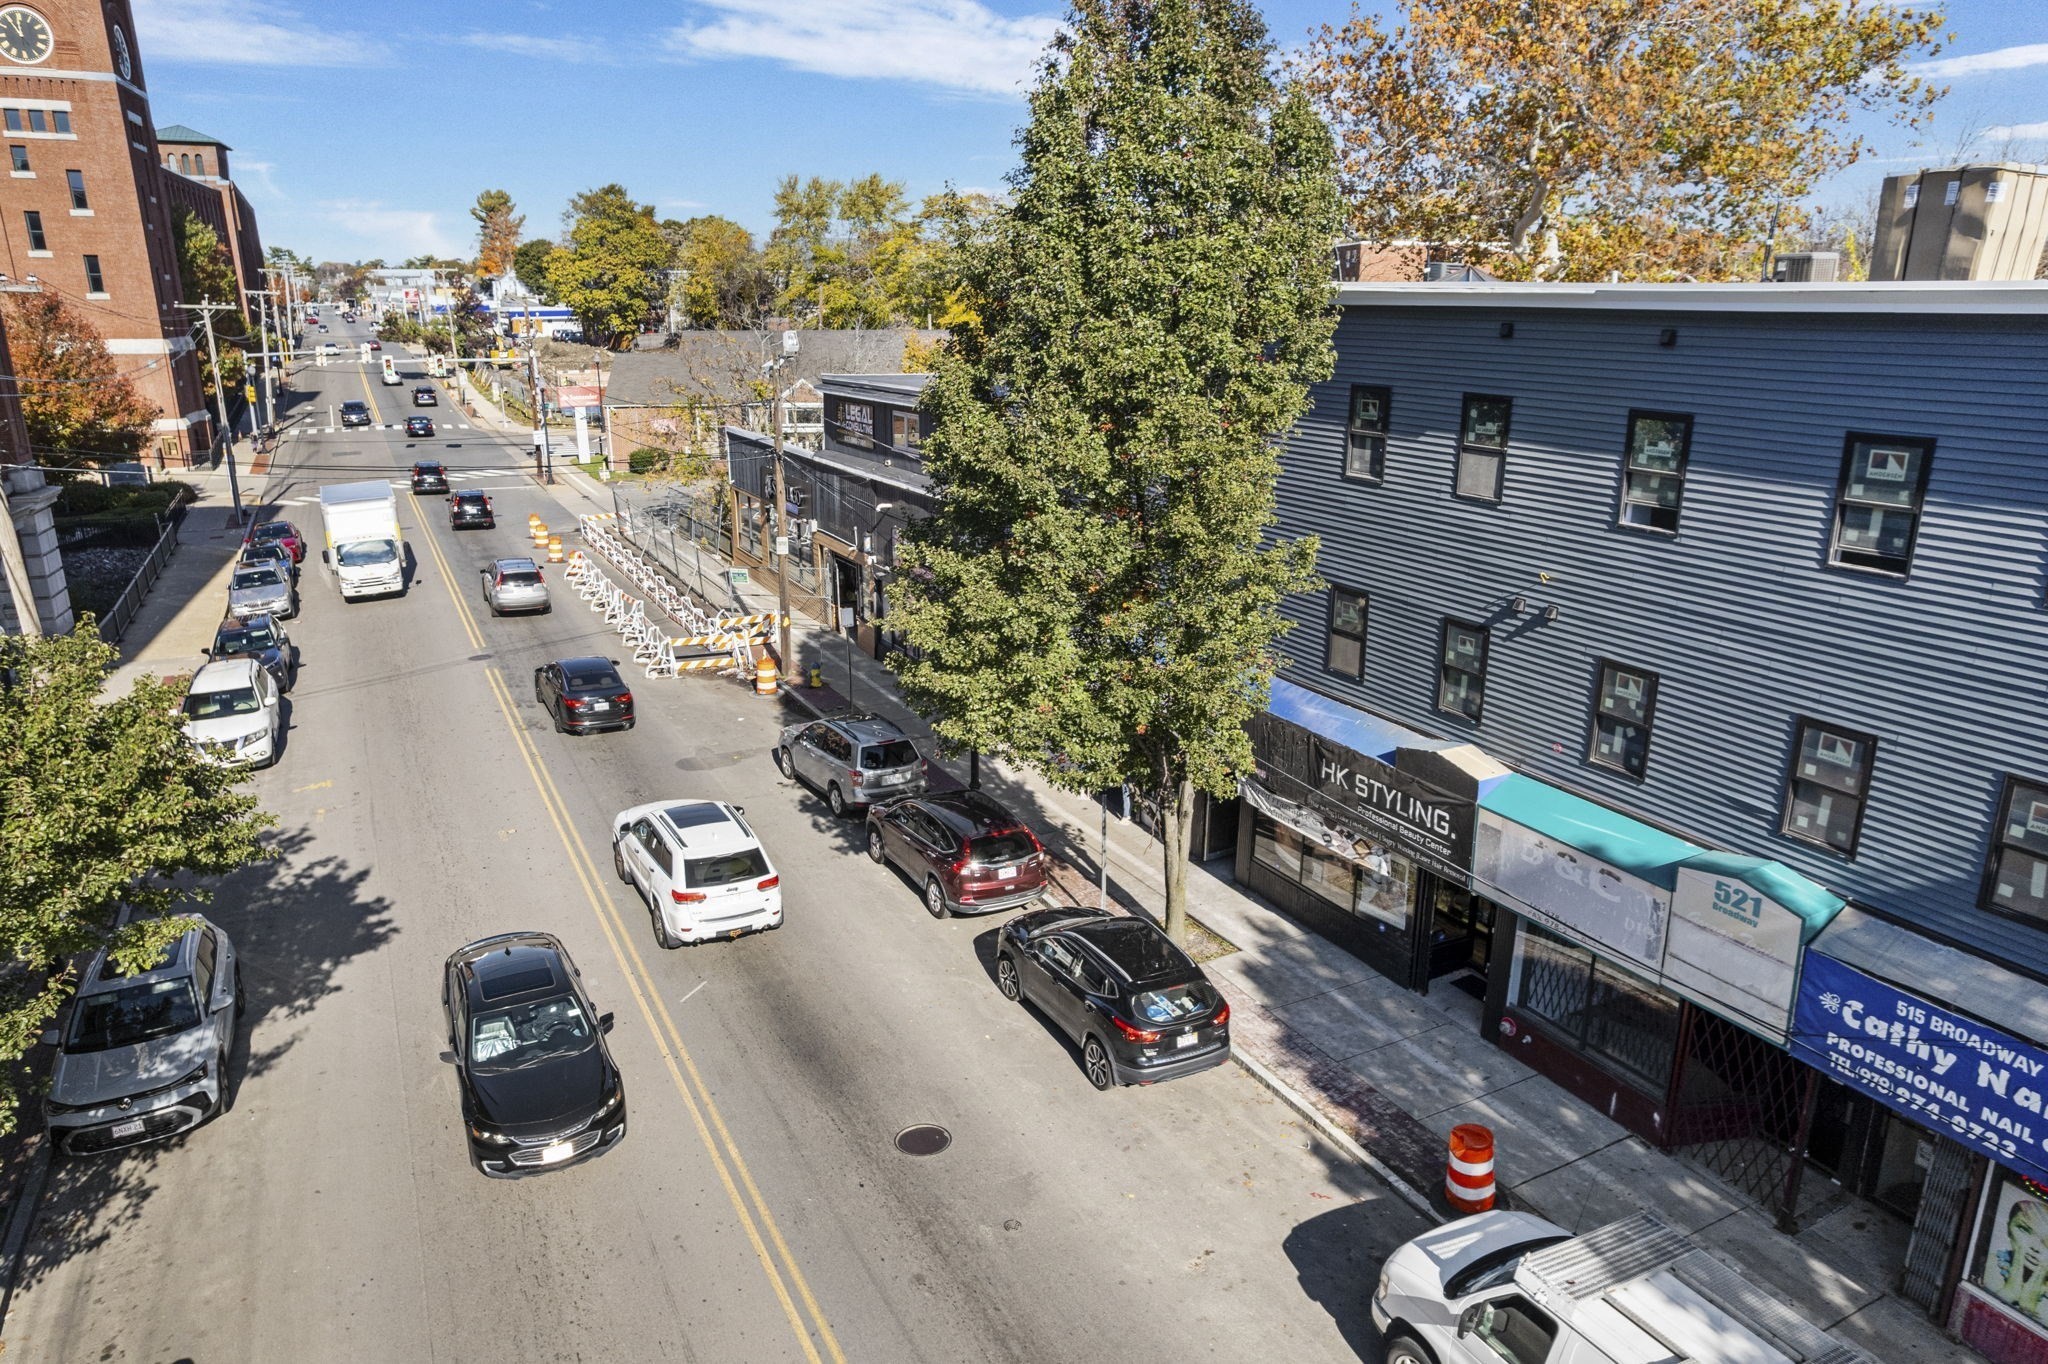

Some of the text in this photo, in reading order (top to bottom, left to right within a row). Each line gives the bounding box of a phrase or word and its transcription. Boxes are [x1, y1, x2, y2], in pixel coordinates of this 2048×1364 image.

[845, 402, 873, 424] LEGAL
[1321, 758, 1349, 790] HK
[1355, 773, 1456, 839] STYLING.
[1357, 806, 1398, 831] Professional
[1399, 825, 1425, 845] Beauty
[1425, 838, 1452, 856] Center
[1712, 901, 1759, 928] Broadway
[1713, 880, 1763, 918] 521
[1842, 999, 1958, 1076] Cathy
[1896, 1000, 2045, 1077] 515 BROADWAY
[1826, 1031, 2035, 1145] PROFESSIONAL NAIL
